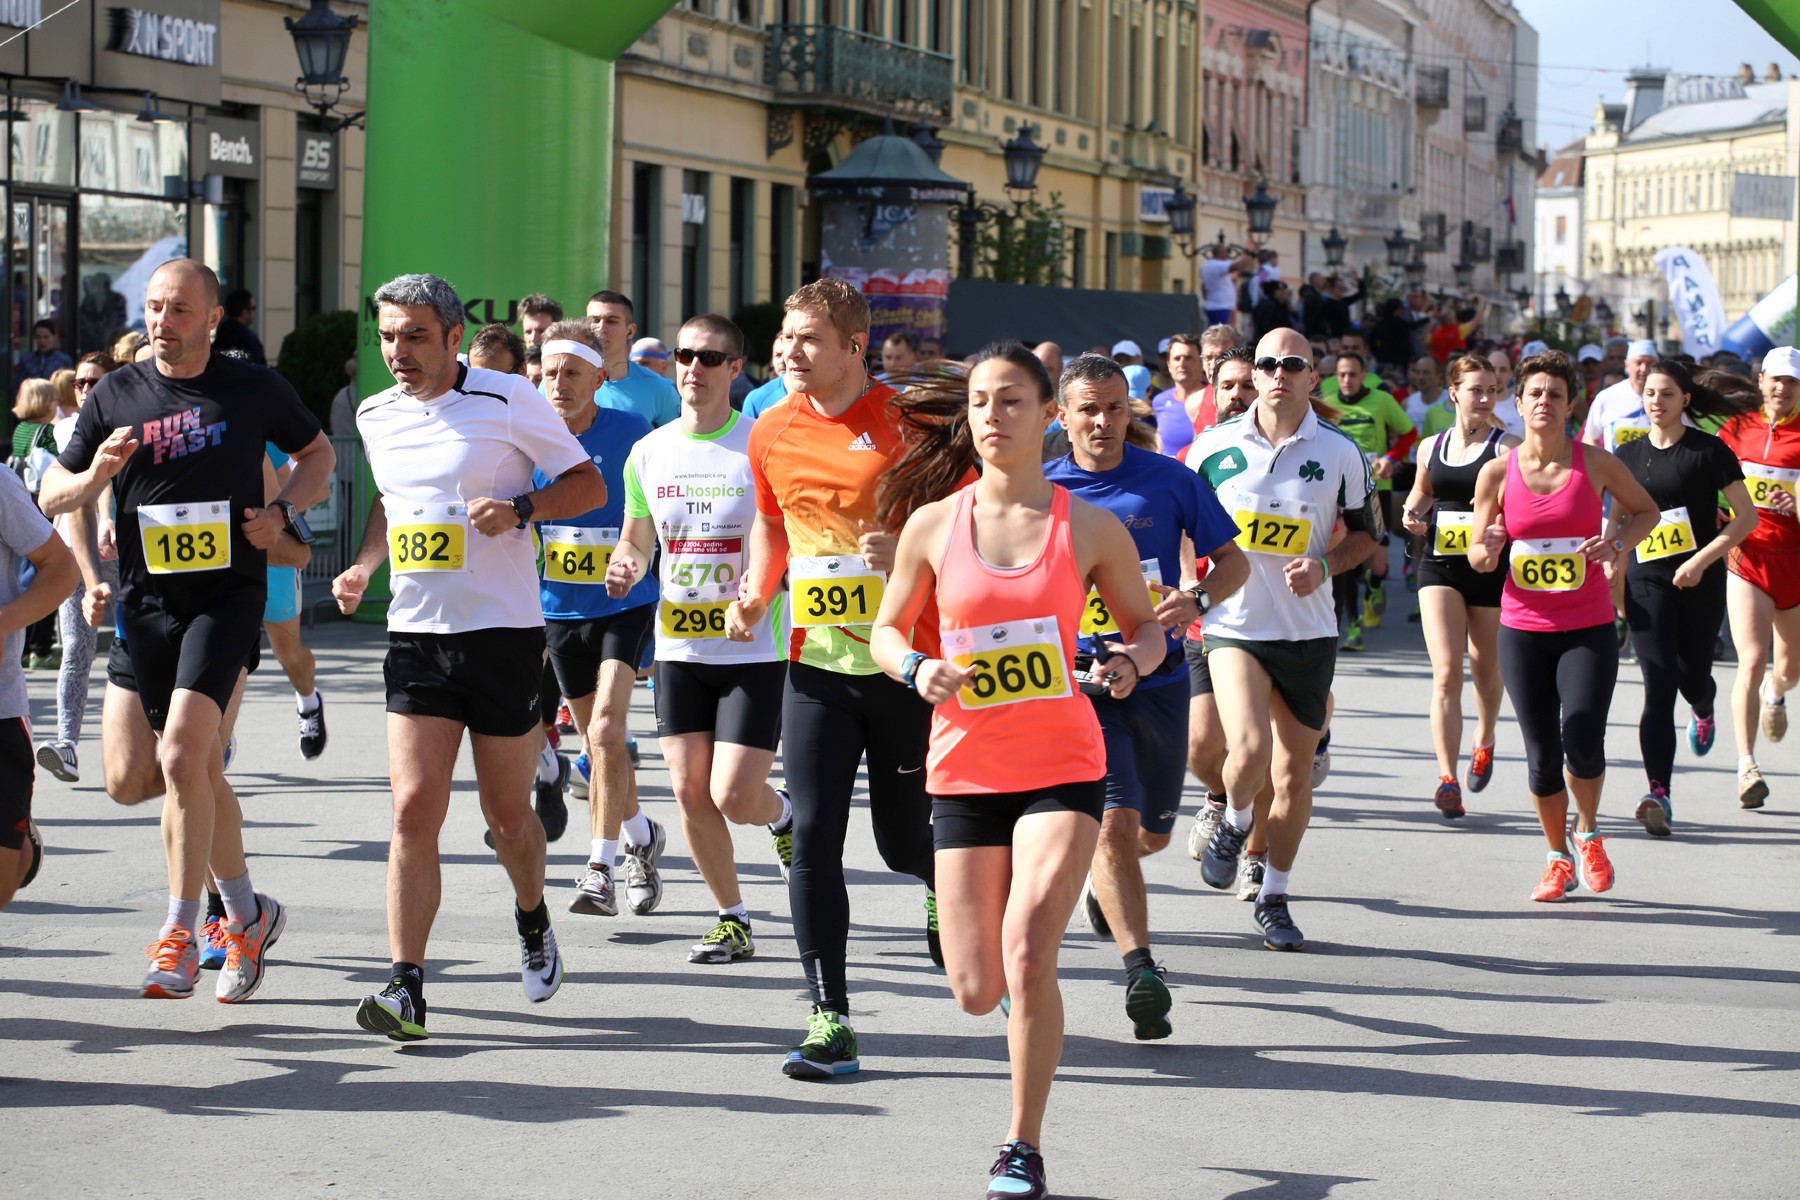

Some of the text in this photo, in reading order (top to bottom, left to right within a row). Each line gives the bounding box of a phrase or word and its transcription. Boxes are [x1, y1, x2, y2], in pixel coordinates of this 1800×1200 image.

[161, 14, 217, 67] SPORT
[210, 131, 253, 165] Bench.
[143, 406, 201, 446] RUN
[153, 420, 227, 465] FAST
[848, 443, 877, 451] adidas
[657, 484, 745, 499] BELhospice
[685, 502, 712, 514] TIM
[158, 531, 217, 563] 183
[398, 531, 450, 563] 382
[1247, 518, 1300, 548] 127
[1644, 528, 1684, 553] 214
[563, 550, 595, 576] 64
[1522, 558, 1577, 585] 663
[807, 584, 867, 617] 391
[671, 607, 725, 632] 296
[969, 651, 1052, 698] 660
